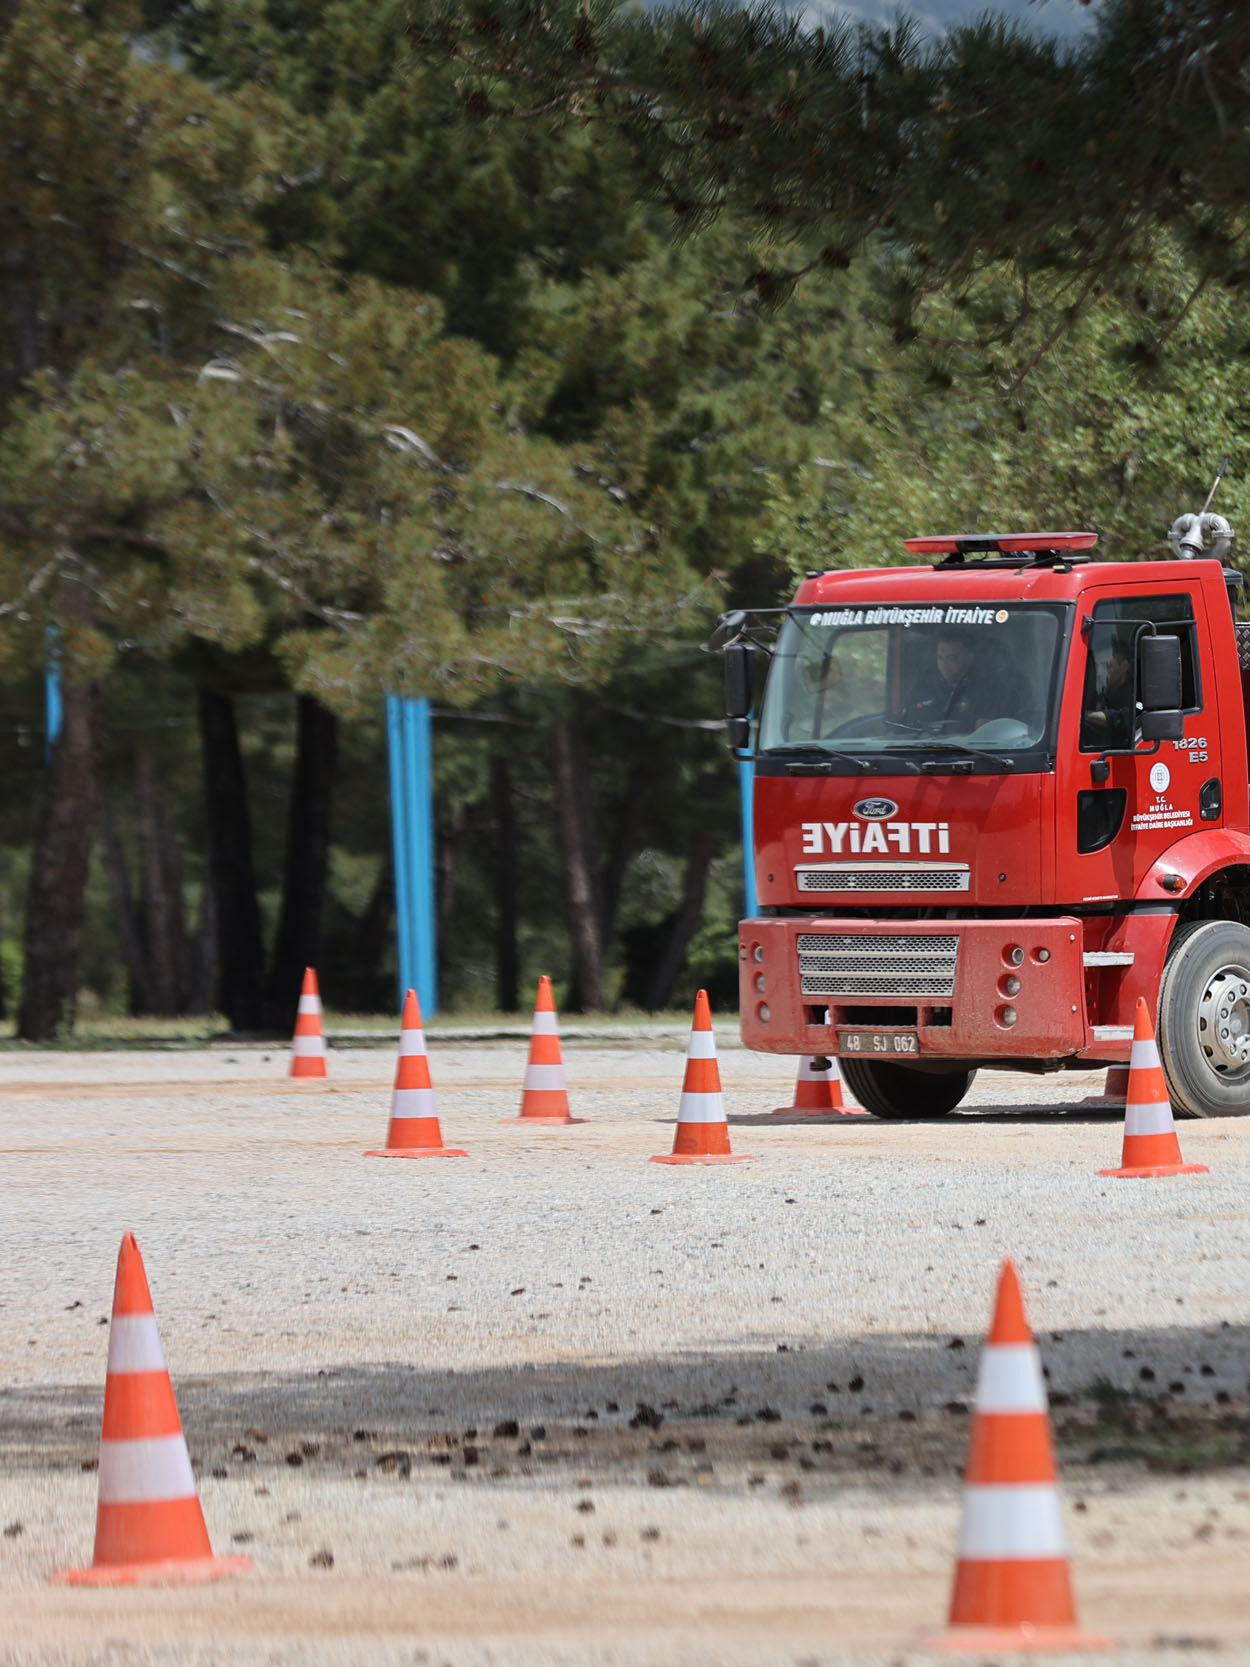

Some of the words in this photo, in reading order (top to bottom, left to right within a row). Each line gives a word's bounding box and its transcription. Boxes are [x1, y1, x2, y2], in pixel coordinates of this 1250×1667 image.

[821, 608, 862, 626] MUĞLA
[864, 606, 943, 628] BÜYÜKŞEHİR
[945, 606, 995, 624] İTFAİYE
[1172, 737, 1208, 750] 1826
[1189, 751, 1209, 763] E5
[862, 801, 887, 815] Ford
[1149, 803, 1173, 812] MUĞLA
[846, 1035, 860, 1051] 48
[873, 1035, 887, 1051] SJ
[894, 1036, 916, 1052] 062
